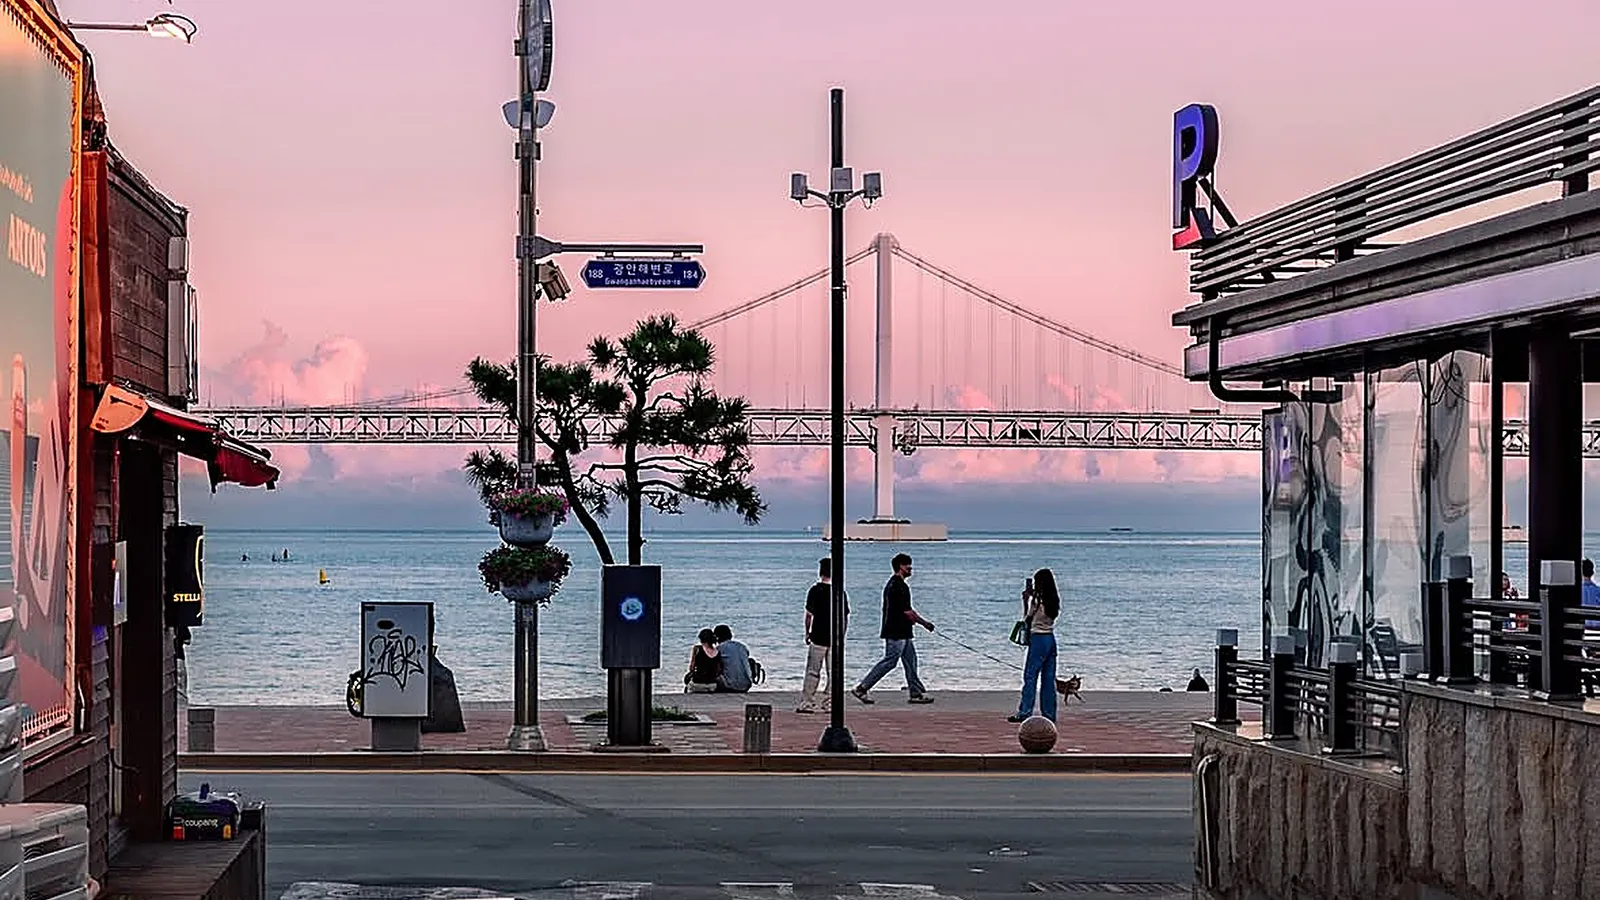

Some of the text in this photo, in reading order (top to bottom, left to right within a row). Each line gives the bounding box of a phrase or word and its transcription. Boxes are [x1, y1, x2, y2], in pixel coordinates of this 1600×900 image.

[8, 212, 46, 278] ARTOIS
[588, 268, 604, 279] 188
[613, 263, 674, 276] 광안해변로
[683, 269, 699, 279] 184
[185, 818, 219, 829] coupang
